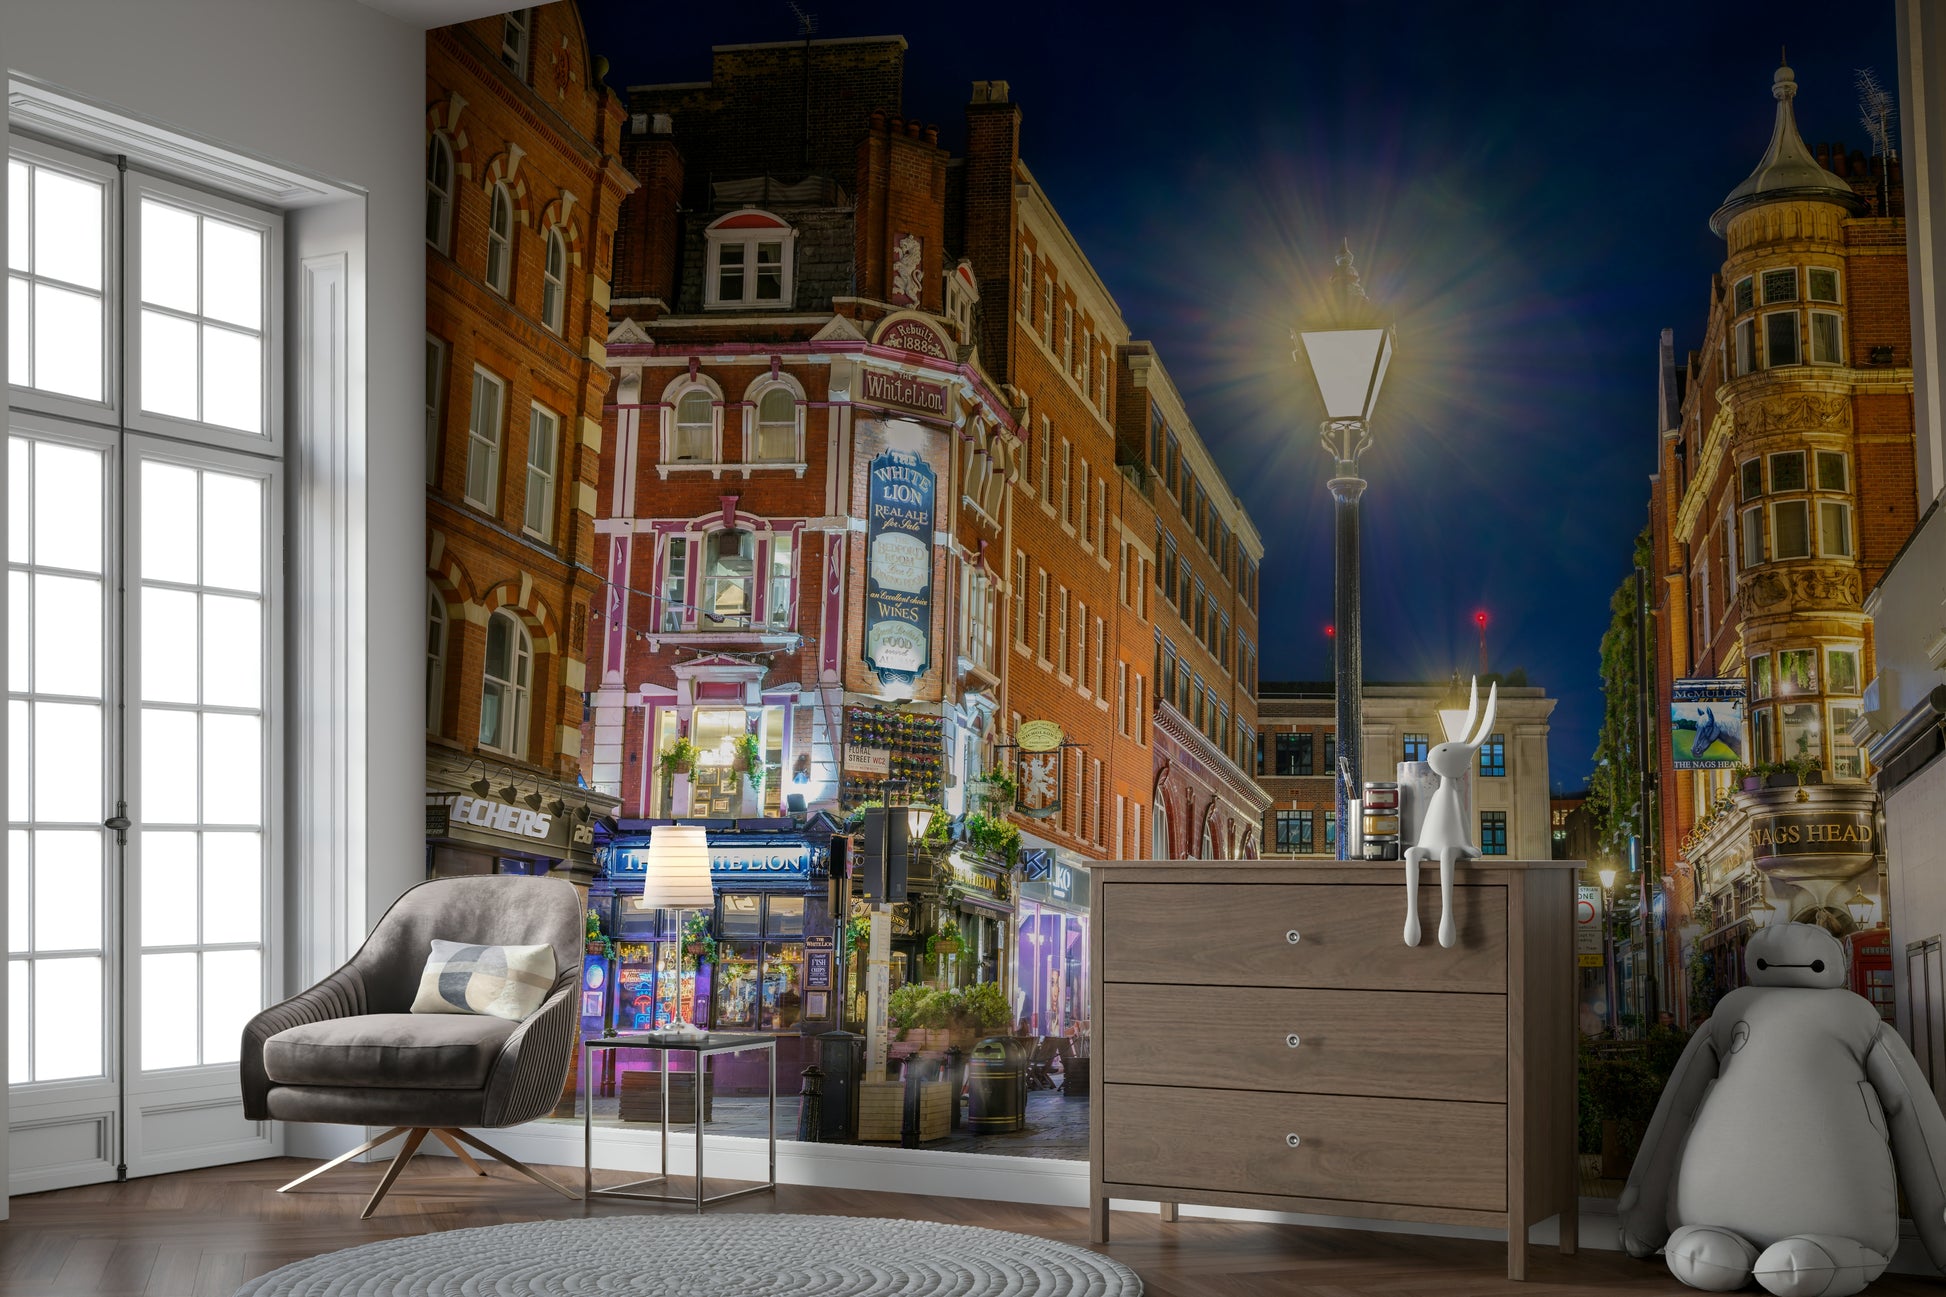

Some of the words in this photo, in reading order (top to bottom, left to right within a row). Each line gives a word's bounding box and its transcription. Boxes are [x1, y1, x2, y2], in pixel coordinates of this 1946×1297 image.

[897, 323, 934, 343] Rebuilt
[903, 336, 928, 354] 1888
[891, 451, 917, 467] THE
[873, 465, 932, 494] WHITE
[883, 485, 922, 506] LION
[875, 504, 905, 518] REAL
[906, 509, 929, 525] ALE
[877, 601, 919, 622] WINES
[882, 636, 913, 650] FOOD
[1675, 689, 1747, 698] McMULLEN
[849, 745, 871, 756] FLORAL
[849, 754, 871, 764] STREET
[872, 757, 886, 766] WC2
[1674, 761, 1691, 769] THE
[1692, 760, 1716, 769] NAGS
[1718, 760, 1743, 769] HEAD
[573, 824, 594, 845] 26
[1751, 825, 1800, 847] NAGS
[1806, 823, 1873, 843] HEAD
[622, 852, 649, 872] TH
[710, 855, 742, 871] ITE
[747, 855, 802, 871] LION
